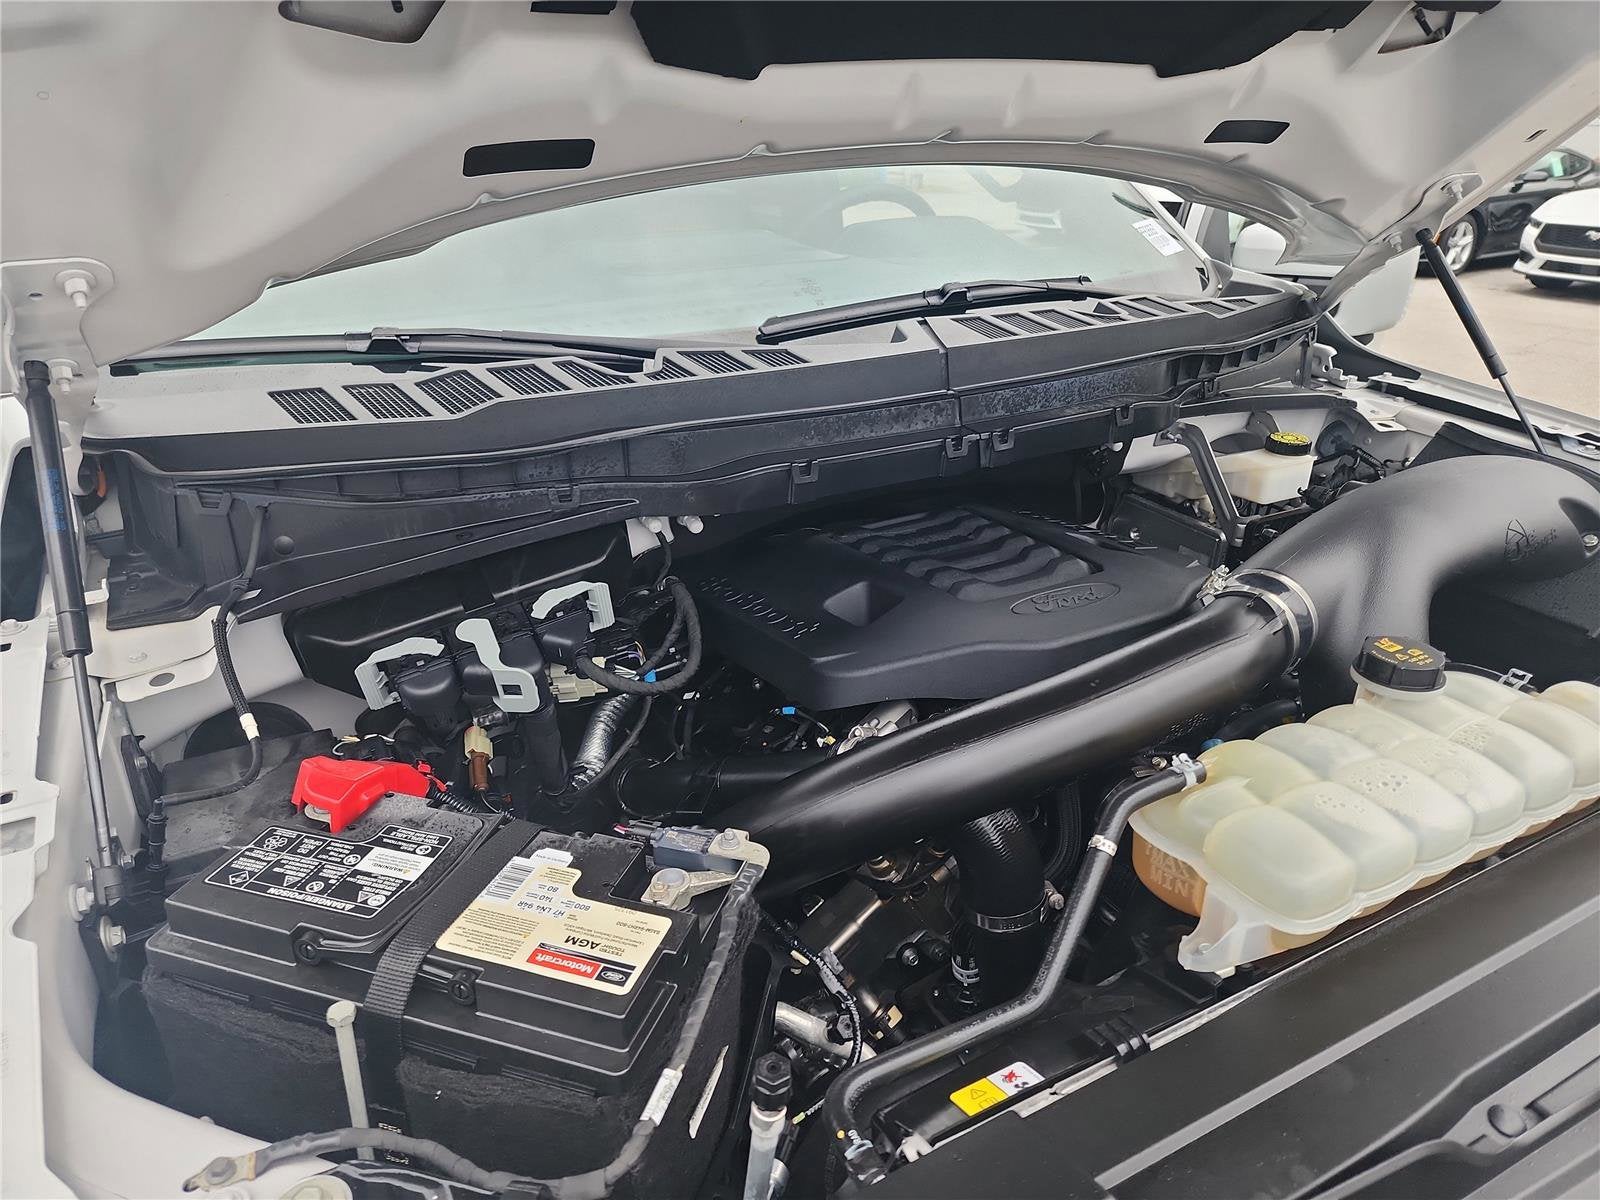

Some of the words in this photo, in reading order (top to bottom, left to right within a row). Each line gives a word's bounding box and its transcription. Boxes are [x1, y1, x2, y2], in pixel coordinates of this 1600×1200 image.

[1150, 864, 1189, 897] MIN
[267, 888, 345, 908] DANGER/POISON
[517, 901, 533, 909] 94R
[536, 905, 552, 913] LN4
[565, 936, 601, 949] AGM
[599, 948, 622, 956] TESTED
[536, 954, 593, 973] Motorcraft
